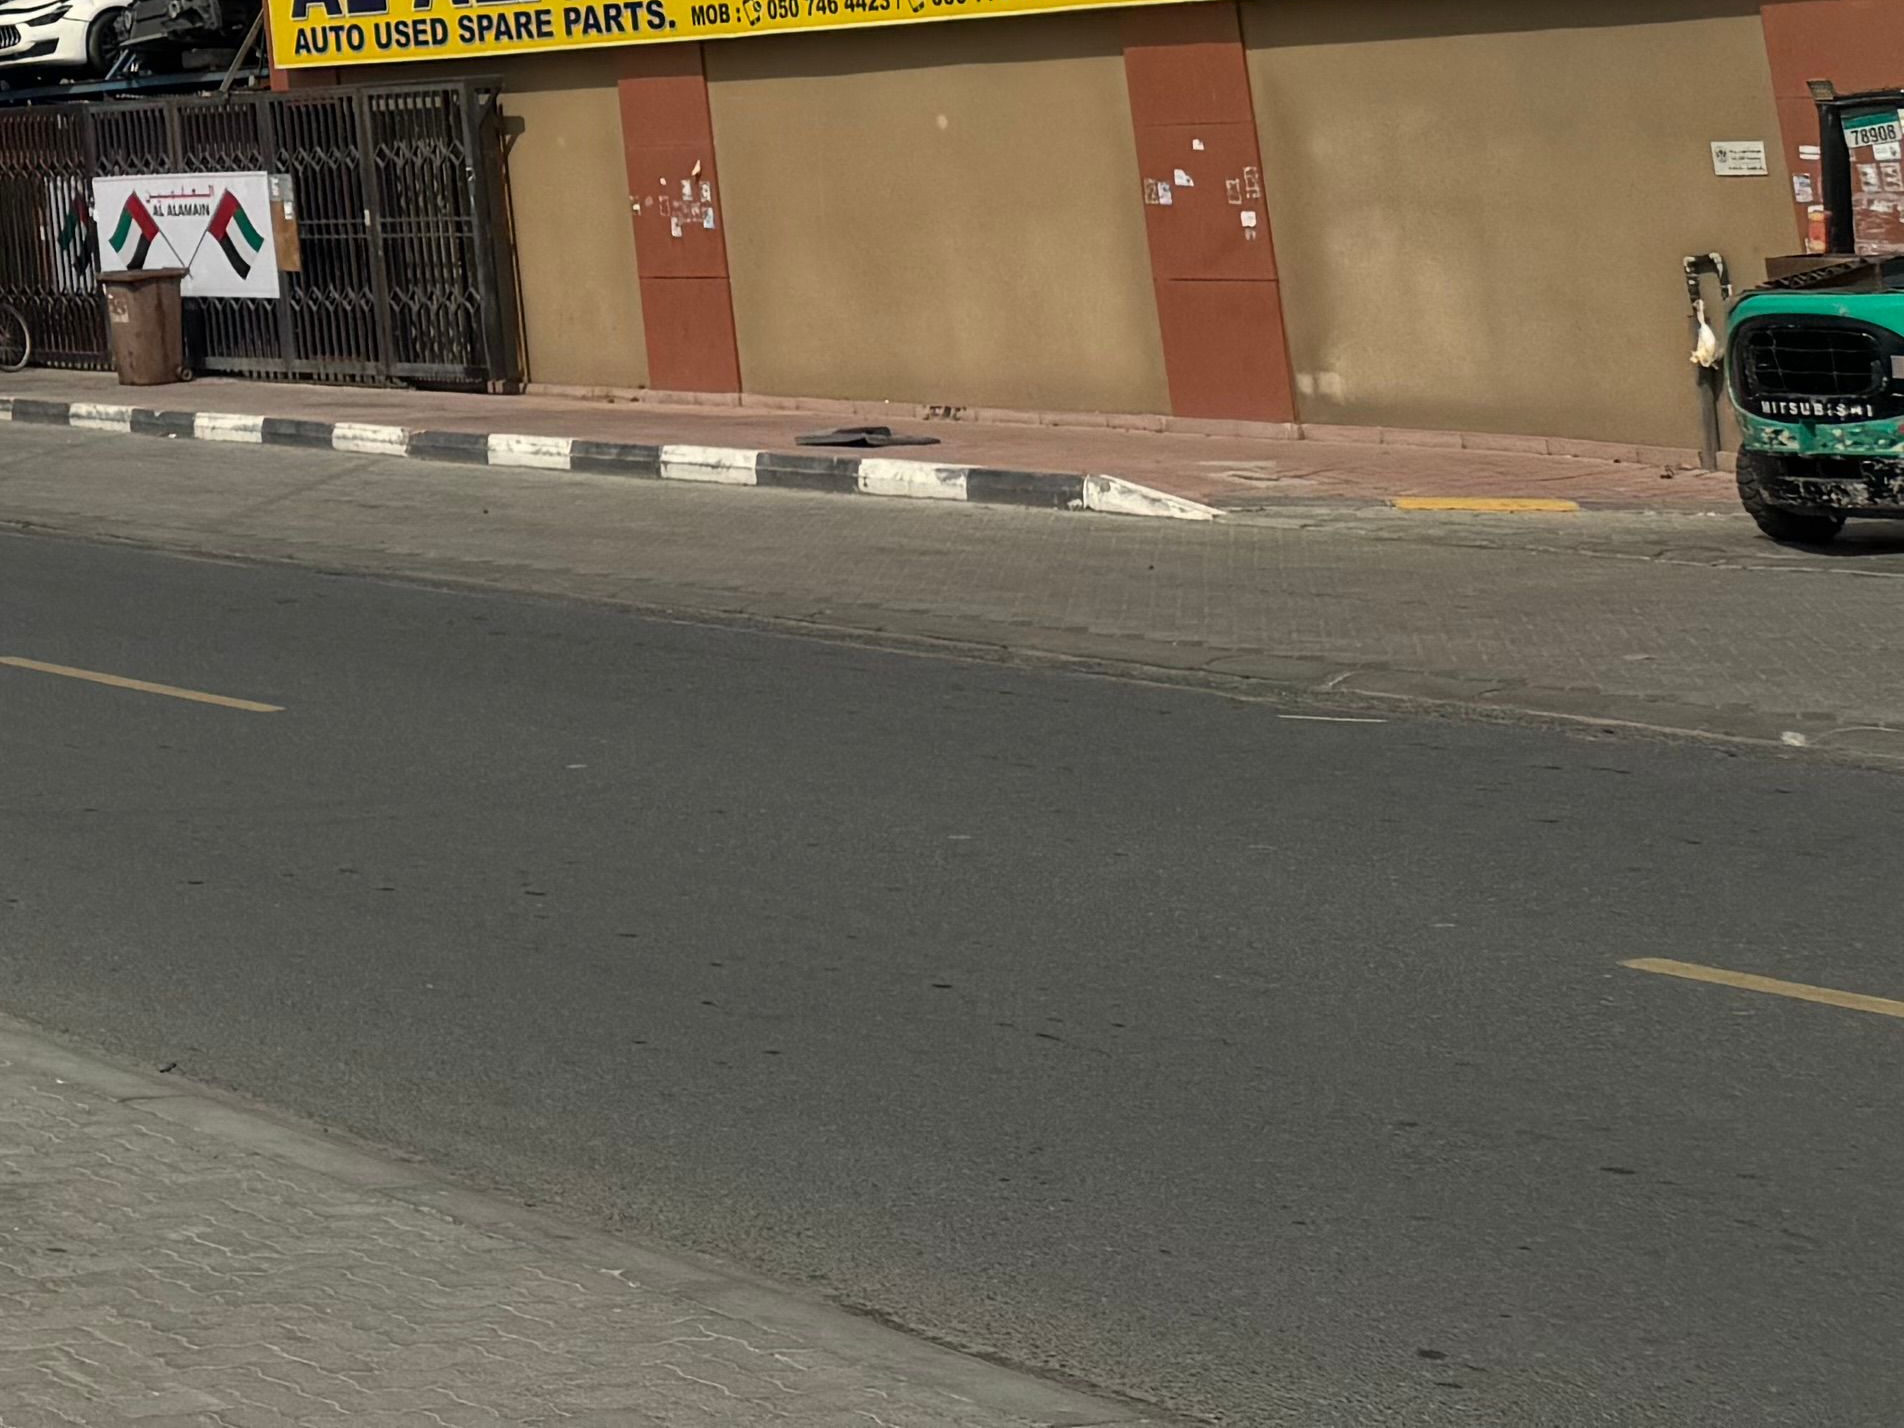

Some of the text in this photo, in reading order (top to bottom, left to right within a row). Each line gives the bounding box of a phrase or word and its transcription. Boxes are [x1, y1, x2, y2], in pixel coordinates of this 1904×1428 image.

[295, 24, 365, 55] AUTO
[375, 16, 449, 49] USED
[459, 7, 553, 43] SPARE
[153, 204, 210, 216] AL ALAMAIN
